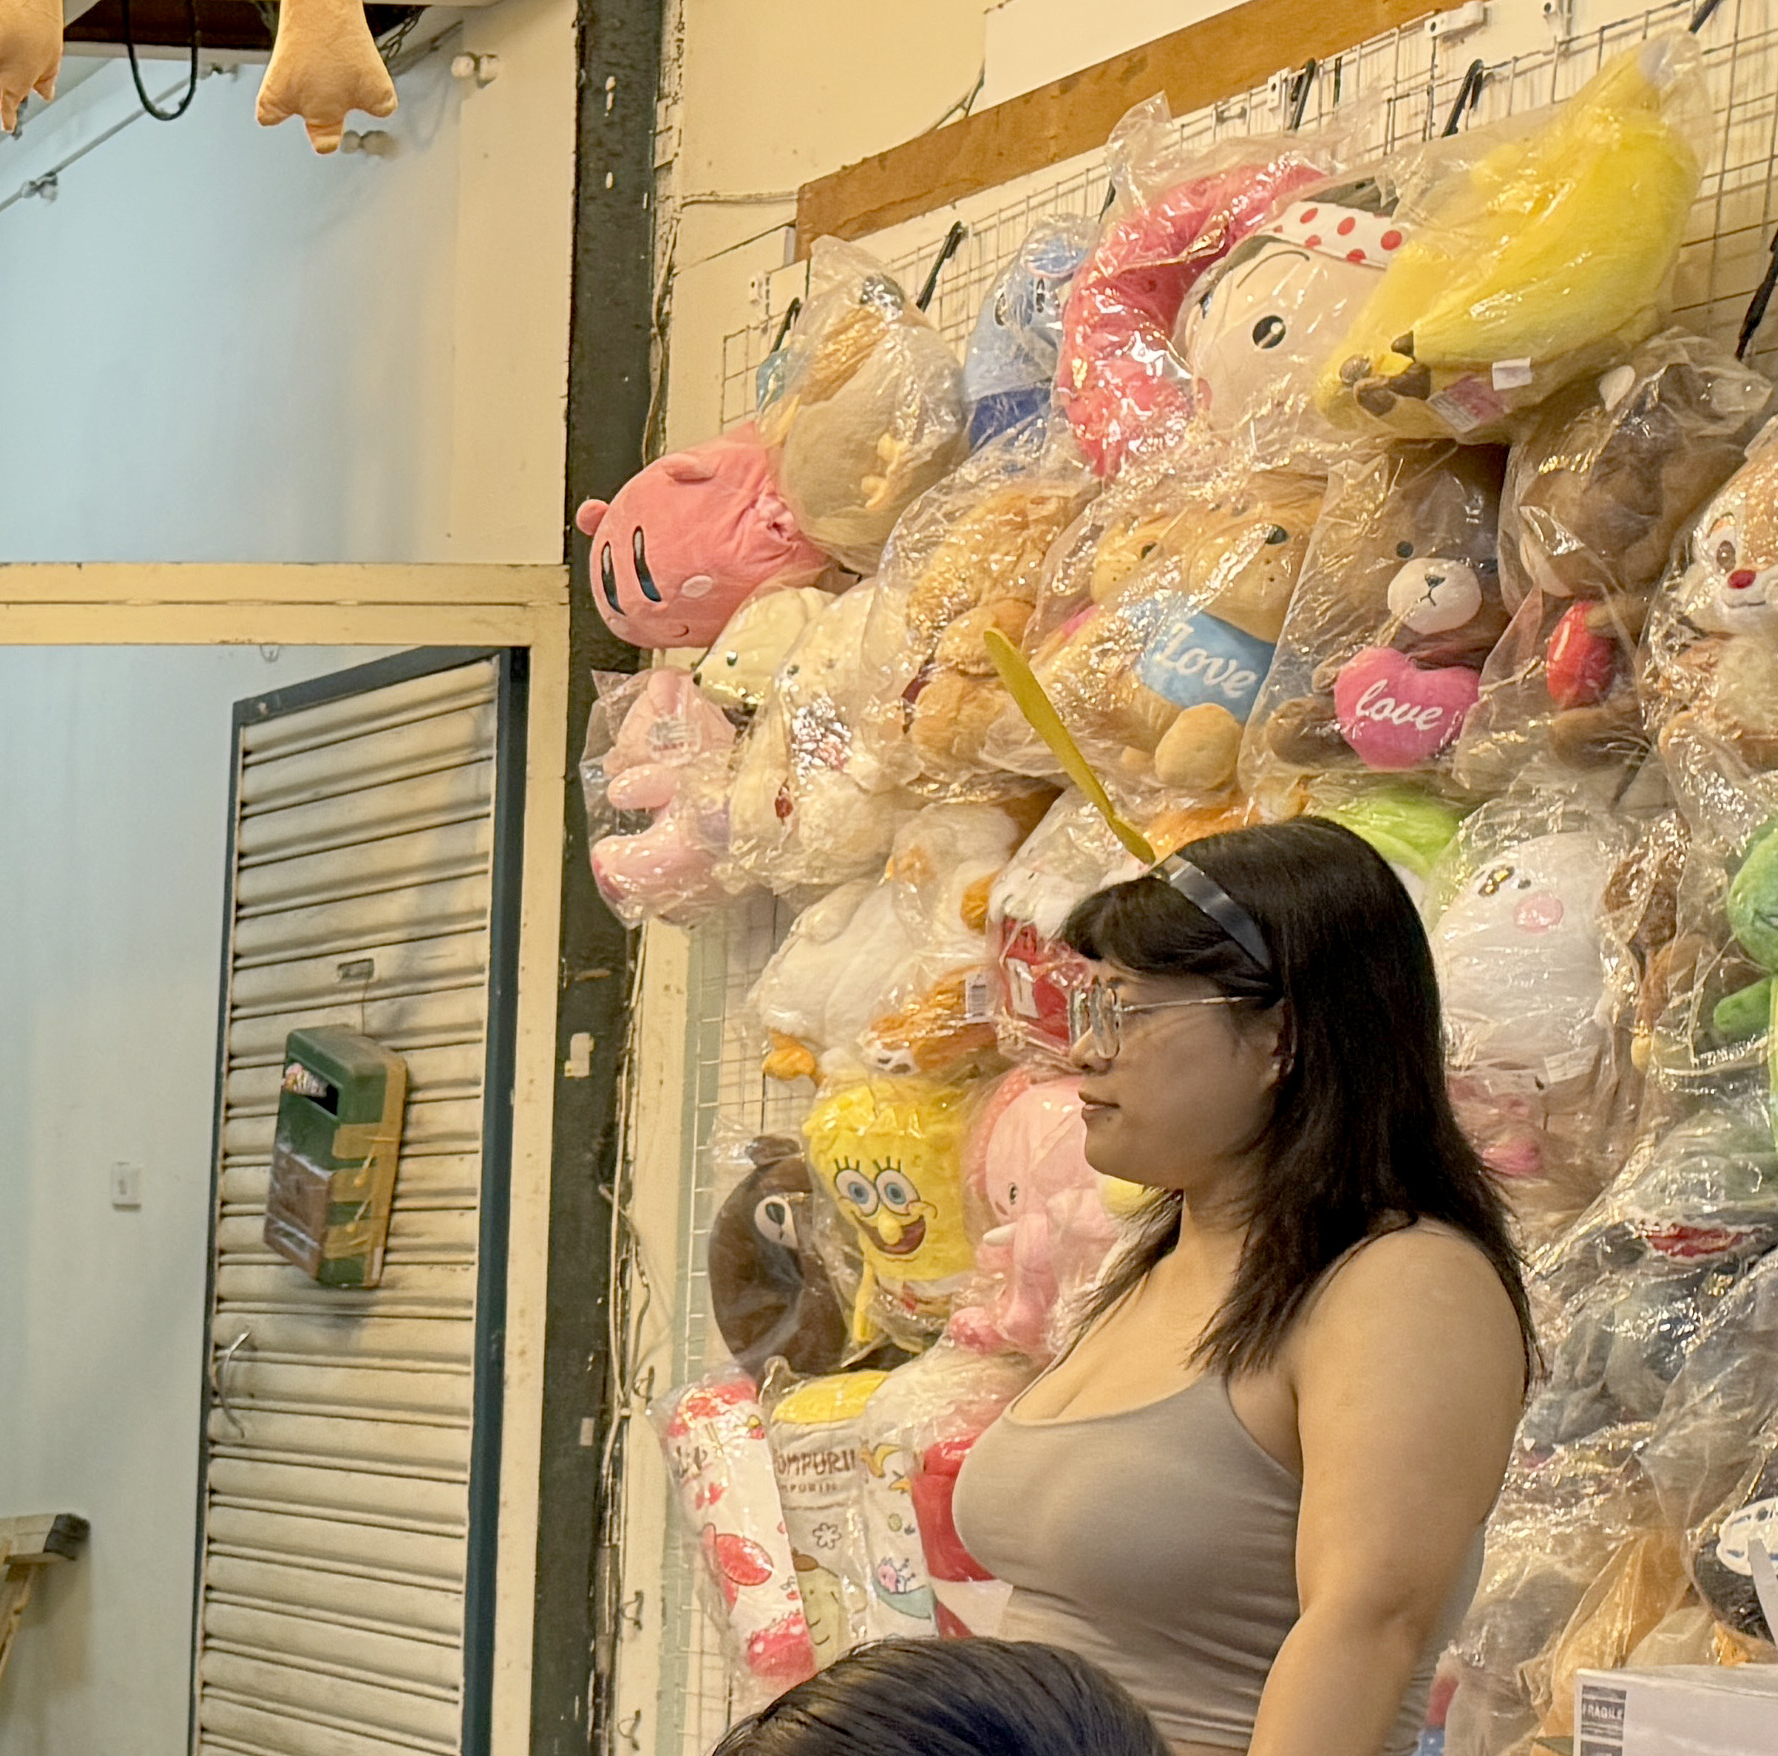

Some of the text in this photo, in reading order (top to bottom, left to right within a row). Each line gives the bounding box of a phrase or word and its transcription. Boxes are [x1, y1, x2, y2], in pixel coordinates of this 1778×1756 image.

[1153, 622, 1258, 699] Love
[1356, 678, 1445, 731] love
[1582, 1702, 1624, 1720] FRAGILE
